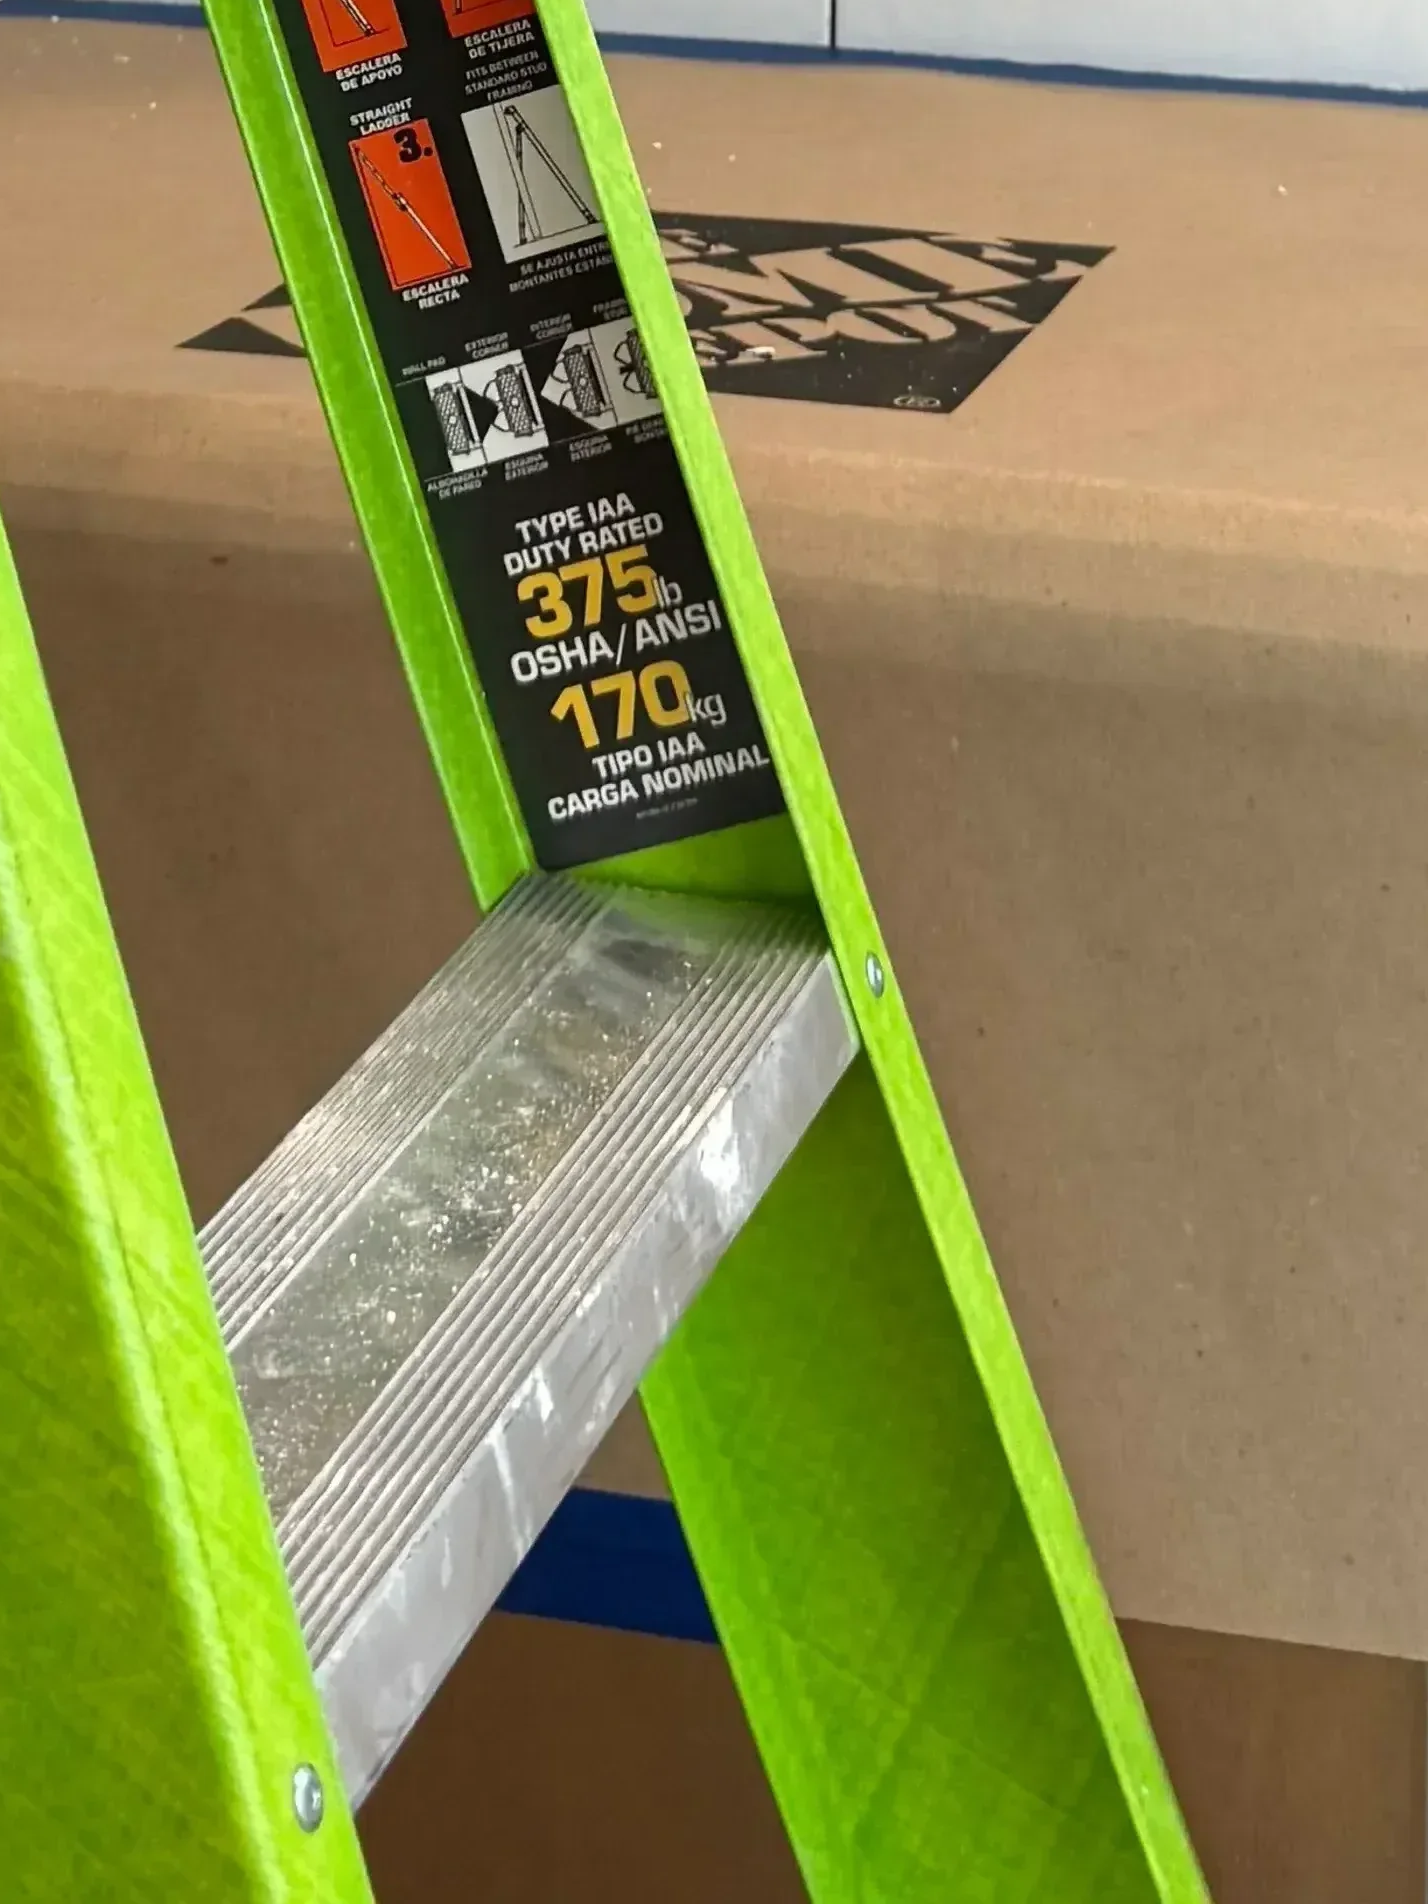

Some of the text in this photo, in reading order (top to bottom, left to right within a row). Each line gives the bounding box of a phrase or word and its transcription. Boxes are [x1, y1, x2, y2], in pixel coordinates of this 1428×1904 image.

[464, 19, 530, 47] ESCALERA
[468, 31, 534, 59] DE TIJERA
[333, 53, 401, 80] ESCALERA
[339, 64, 402, 91] DE APOYO
[464, 61, 547, 94] STANDARD STUD
[465, 50, 538, 80] FITS BETWEEN
[350, 97, 411, 127] STRAIGHT
[360, 112, 410, 135] LADDER
[393, 128, 433, 162] 3.
[520, 263, 534, 276] SE
[536, 251, 577, 271] AJUSTA
[402, 274, 468, 301] ESCALERA
[509, 266, 573, 292] MONTANTES
[418, 289, 460, 309] RECTA
[515, 493, 635, 542] TYPE IAA
[504, 513, 662, 575] DUTY RATED
[511, 602, 719, 682] OSHA/ANSI
[592, 732, 705, 778] TIPO IAA
[548, 779, 638, 819] CARGA
[642, 741, 768, 796] NOMINAL
